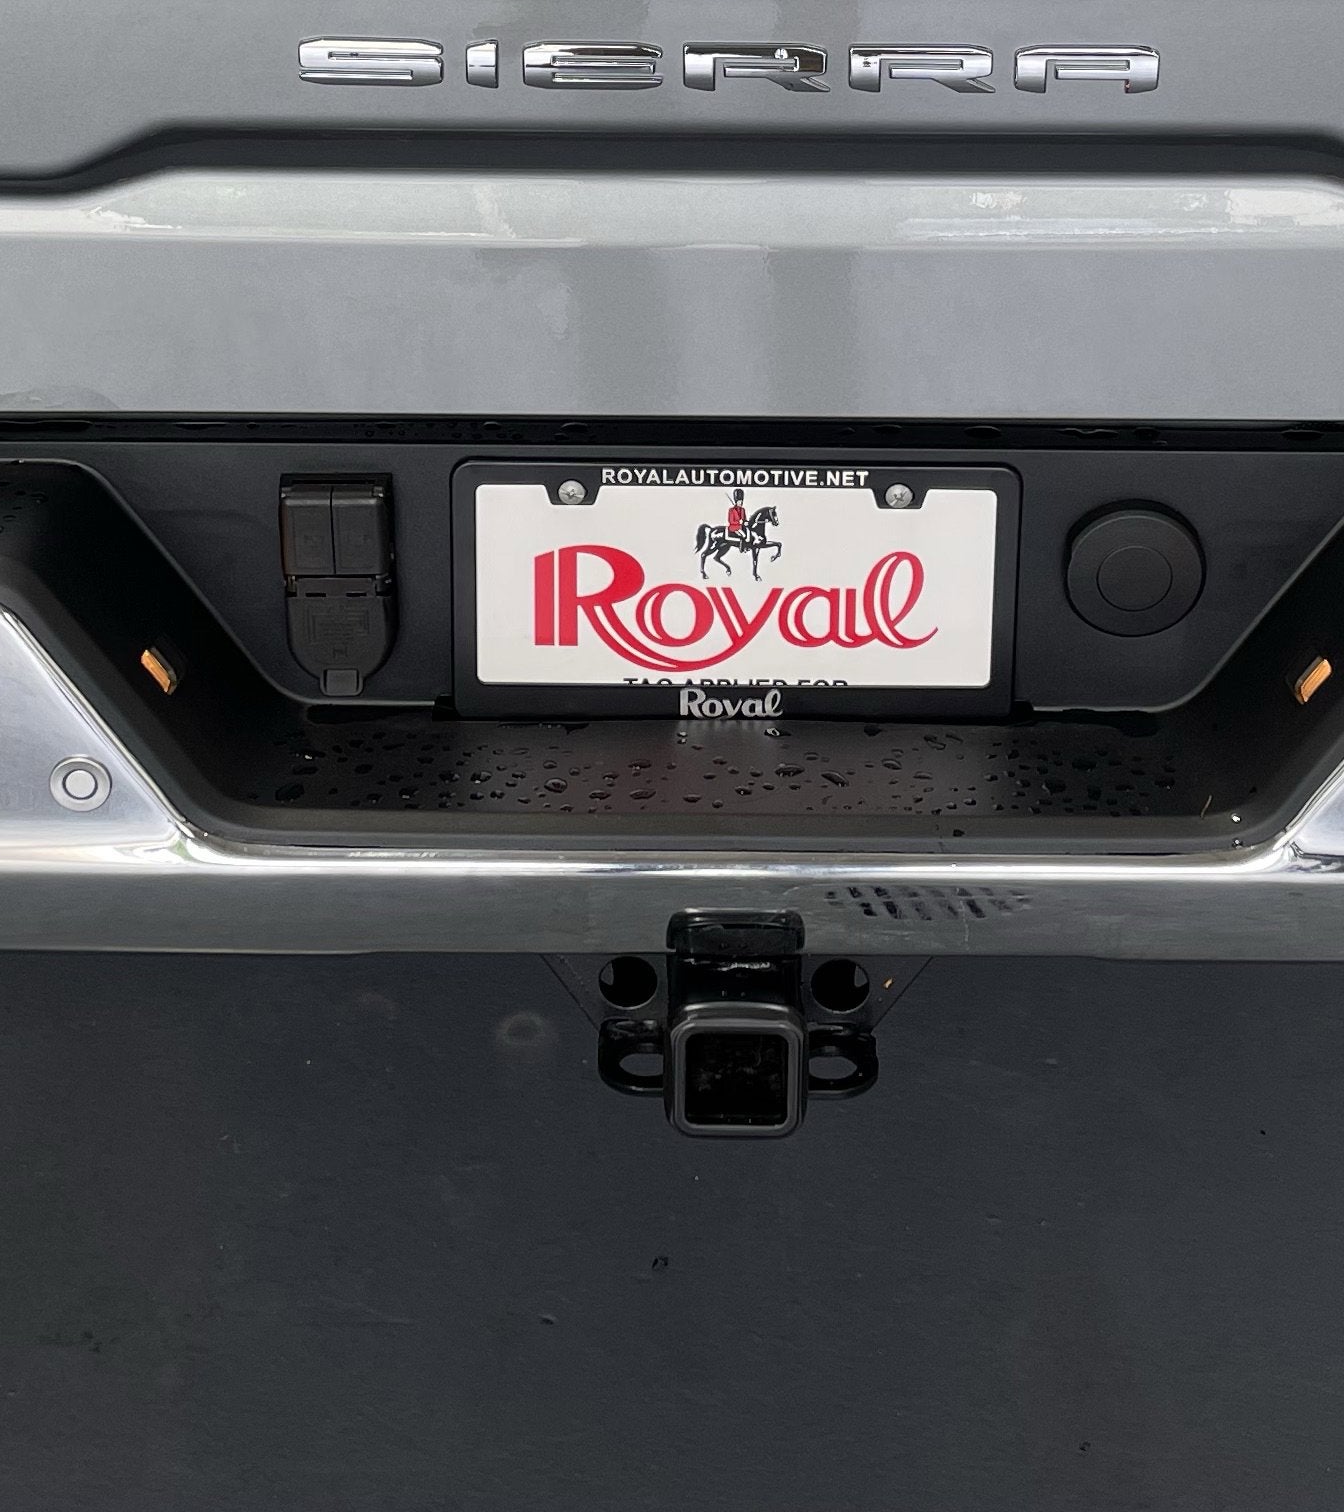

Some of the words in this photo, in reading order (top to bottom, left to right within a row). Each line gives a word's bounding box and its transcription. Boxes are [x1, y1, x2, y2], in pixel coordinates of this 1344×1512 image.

[297, 36, 1160, 94] SIERRA
[602, 467, 869, 487] ROYALAUTOMOTIVE.NET
[533, 544, 939, 673] Royal
[679, 688, 784, 720] Royal
